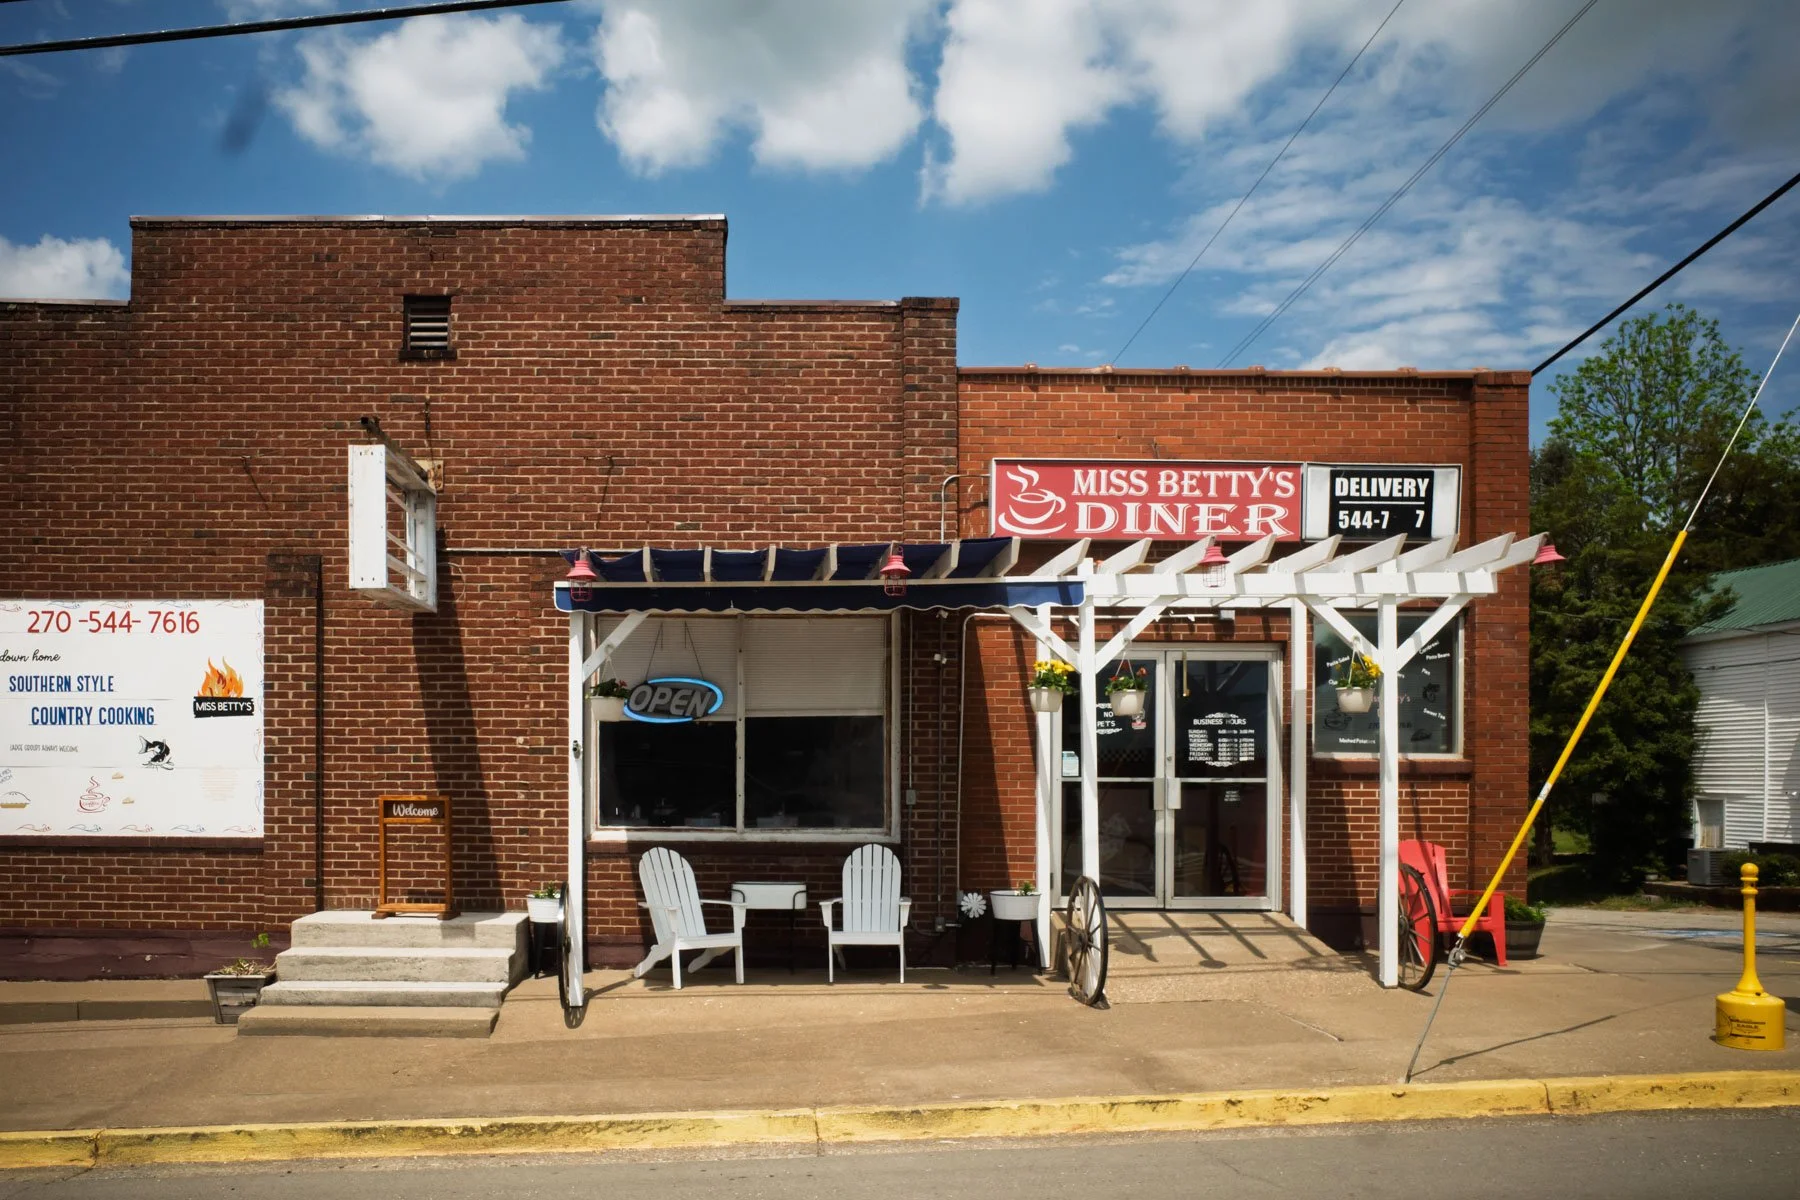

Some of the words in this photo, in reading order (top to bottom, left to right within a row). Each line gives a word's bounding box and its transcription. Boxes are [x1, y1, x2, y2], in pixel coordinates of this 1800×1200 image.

[1071, 469, 1148, 496] MISS
[1158, 467, 1295, 497] BETTY'S
[1335, 477, 1430, 498] DELIVERY
[1074, 503, 1294, 536] DINER
[0, 649, 29, 662] down
[32, 649, 61, 662] home
[9, 675, 71, 693] SOUTHERN
[77, 675, 114, 692] STYLE
[195, 702, 216, 712] MISS
[217, 701, 253, 712] BETTY'S
[629, 684, 713, 717] OPEN
[31, 706, 93, 725] COUNTRY
[99, 706, 155, 725] COOKING
[1193, 718, 1223, 726] BUSINESS
[1225, 718, 1247, 726] HOURS
[393, 803, 439, 816] Welcome
